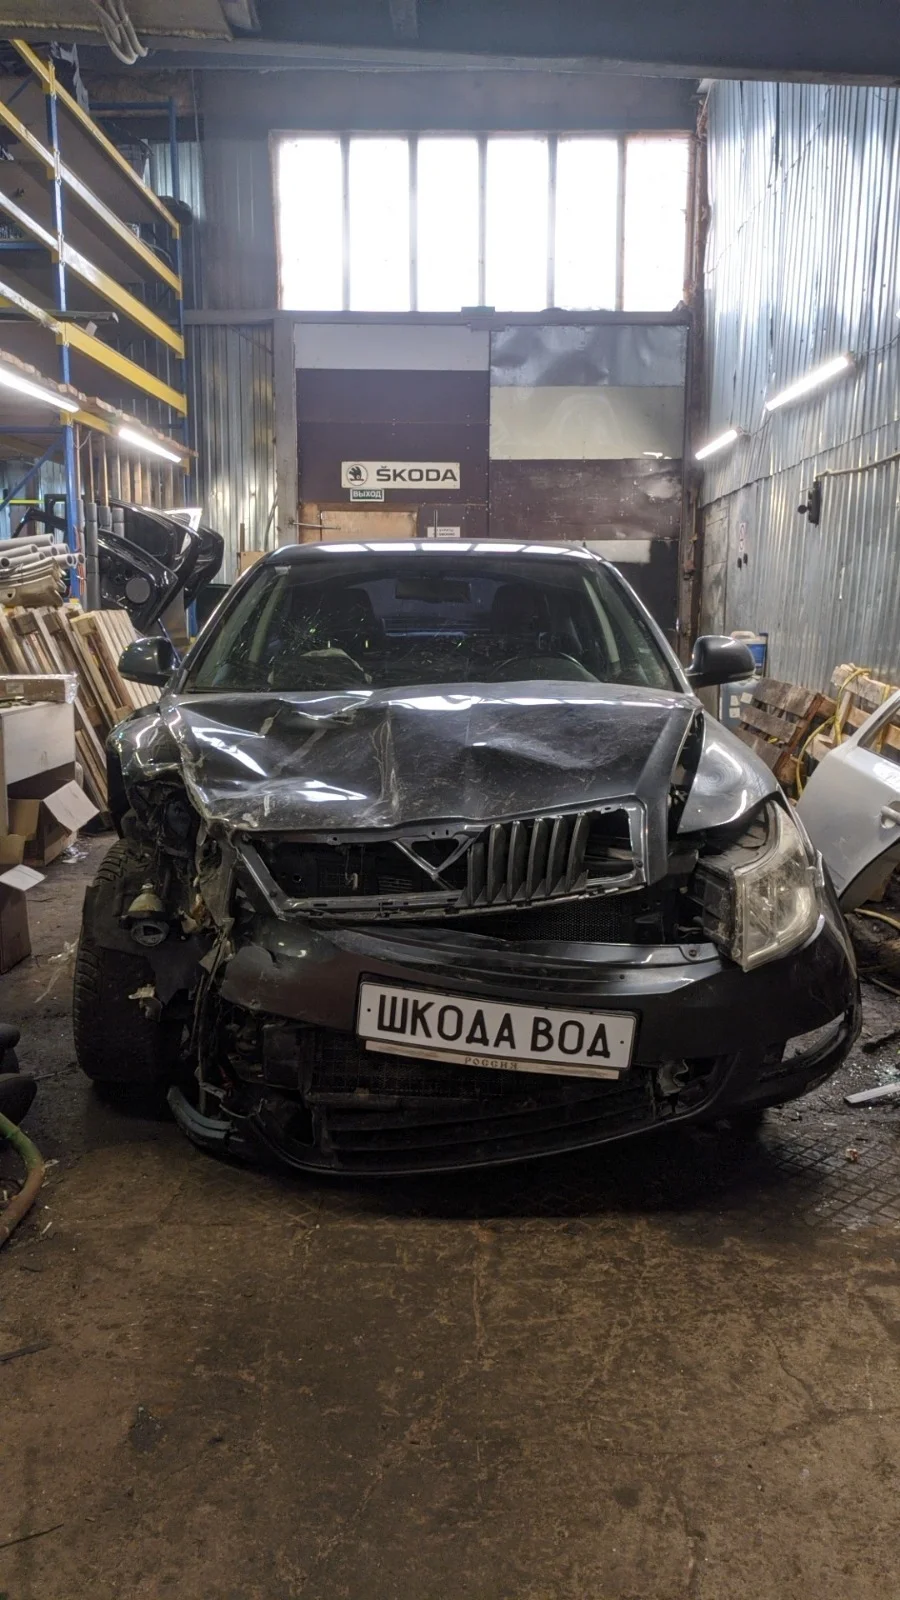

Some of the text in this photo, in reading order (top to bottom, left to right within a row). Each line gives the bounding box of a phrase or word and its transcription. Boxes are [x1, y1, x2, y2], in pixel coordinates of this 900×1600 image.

[376, 465, 457, 482] ŠKODA
[353, 490, 381, 498] ВЫХОД
[377, 994, 610, 1059] ШКОДА ВОД
[465, 1056, 519, 1070] РОССИЯ
